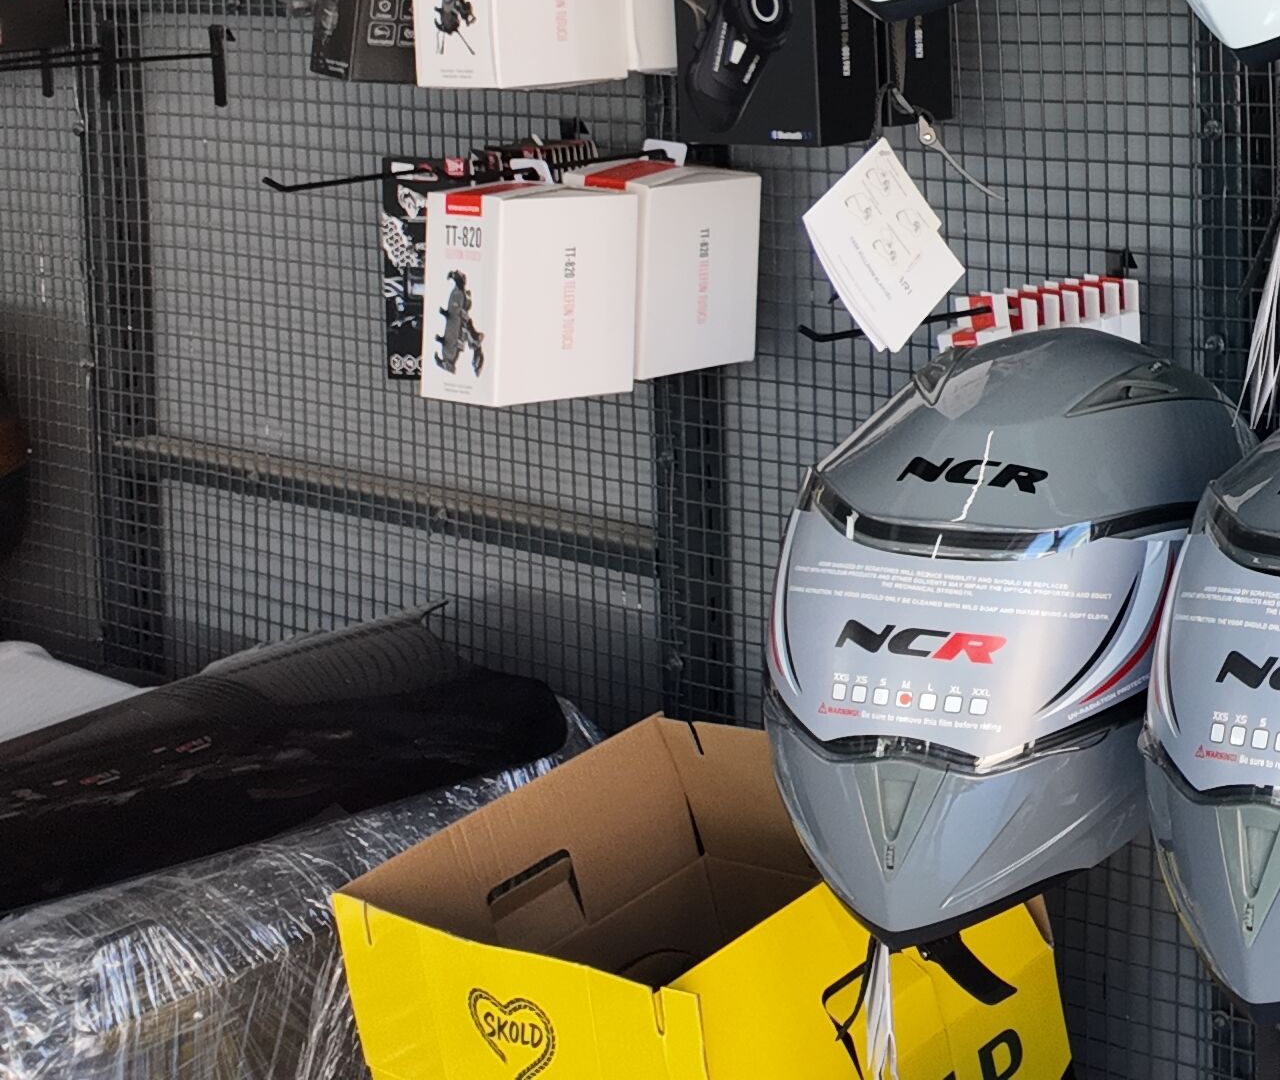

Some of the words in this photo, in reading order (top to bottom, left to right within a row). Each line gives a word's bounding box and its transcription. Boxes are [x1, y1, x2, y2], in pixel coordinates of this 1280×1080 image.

[446, 225, 482, 249] TT-820
[700, 228, 709, 257] TT-820
[564, 247, 576, 278] TT-820
[896, 457, 1049, 494] NCR
[835, 620, 1007, 664] NCR
[856, 675, 868, 684] XS
[880, 678, 887, 686] S
[902, 681, 911, 689] M
[928, 683, 933, 691] L
[950, 685, 962, 694] XL
[972, 688, 990, 697] XXL
[1213, 711, 1228, 721] XXS
[1235, 714, 1248, 724] XS
[1260, 718, 1267, 727] S
[484, 1012, 543, 1048] SKOLD
[943, 1029, 1023, 1080] D
